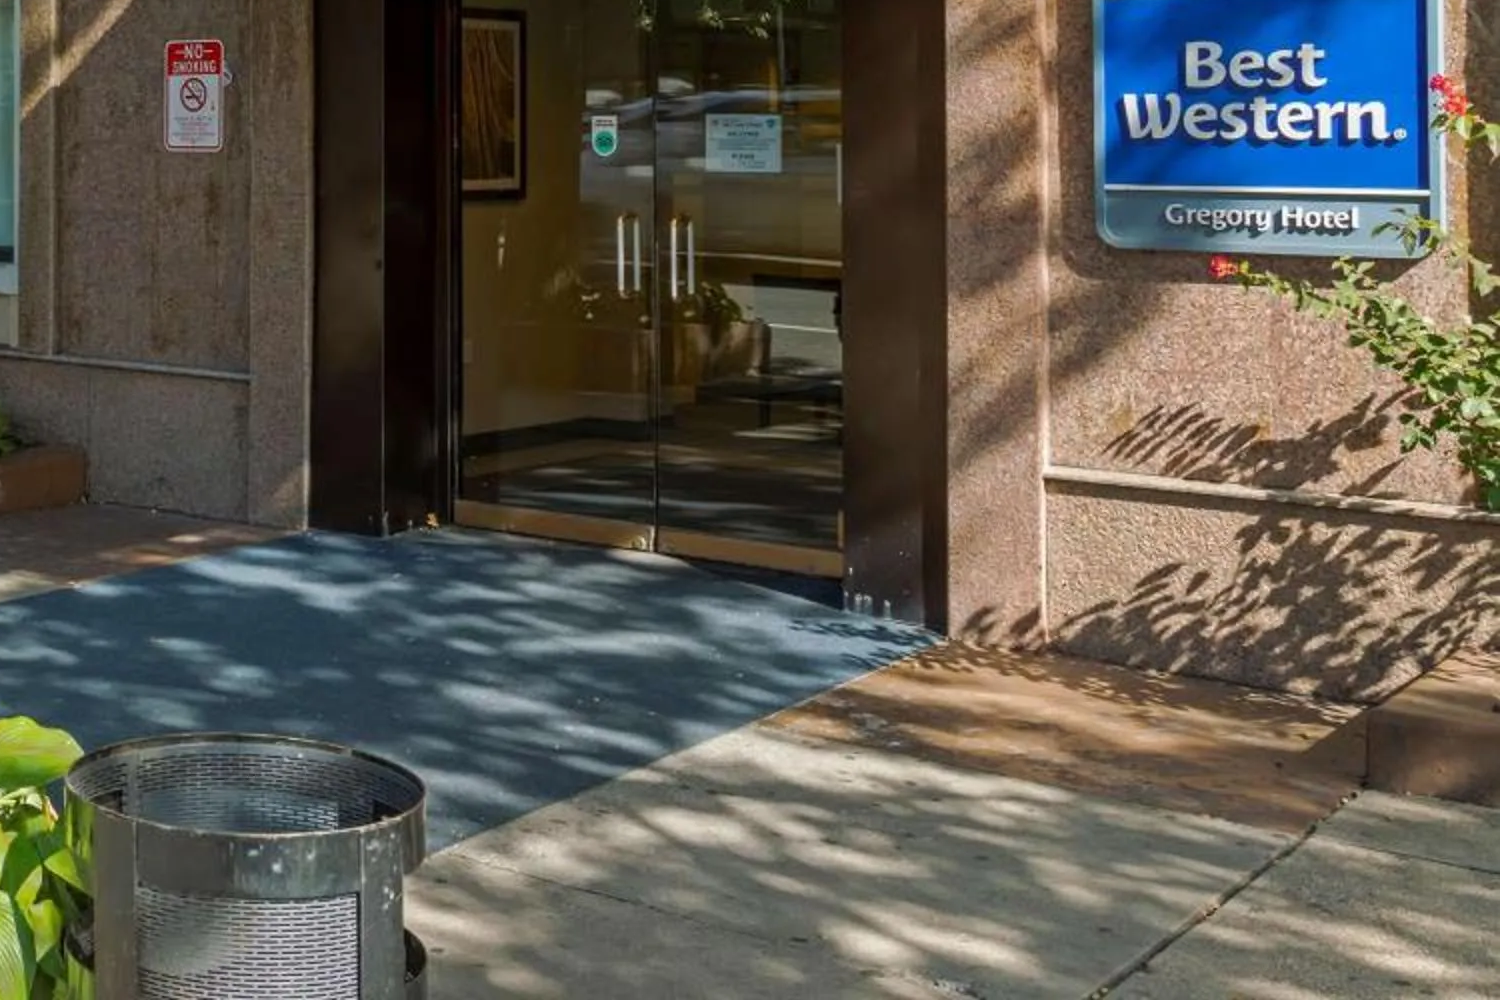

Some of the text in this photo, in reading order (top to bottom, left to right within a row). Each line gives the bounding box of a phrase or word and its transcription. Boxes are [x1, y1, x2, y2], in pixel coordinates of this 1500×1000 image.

[184, 44, 204, 59] NO
[172, 60, 217, 73] SMOKING
[1184, 40, 1329, 89] Best
[1164, 203, 1361, 232] Gregory Hotel
